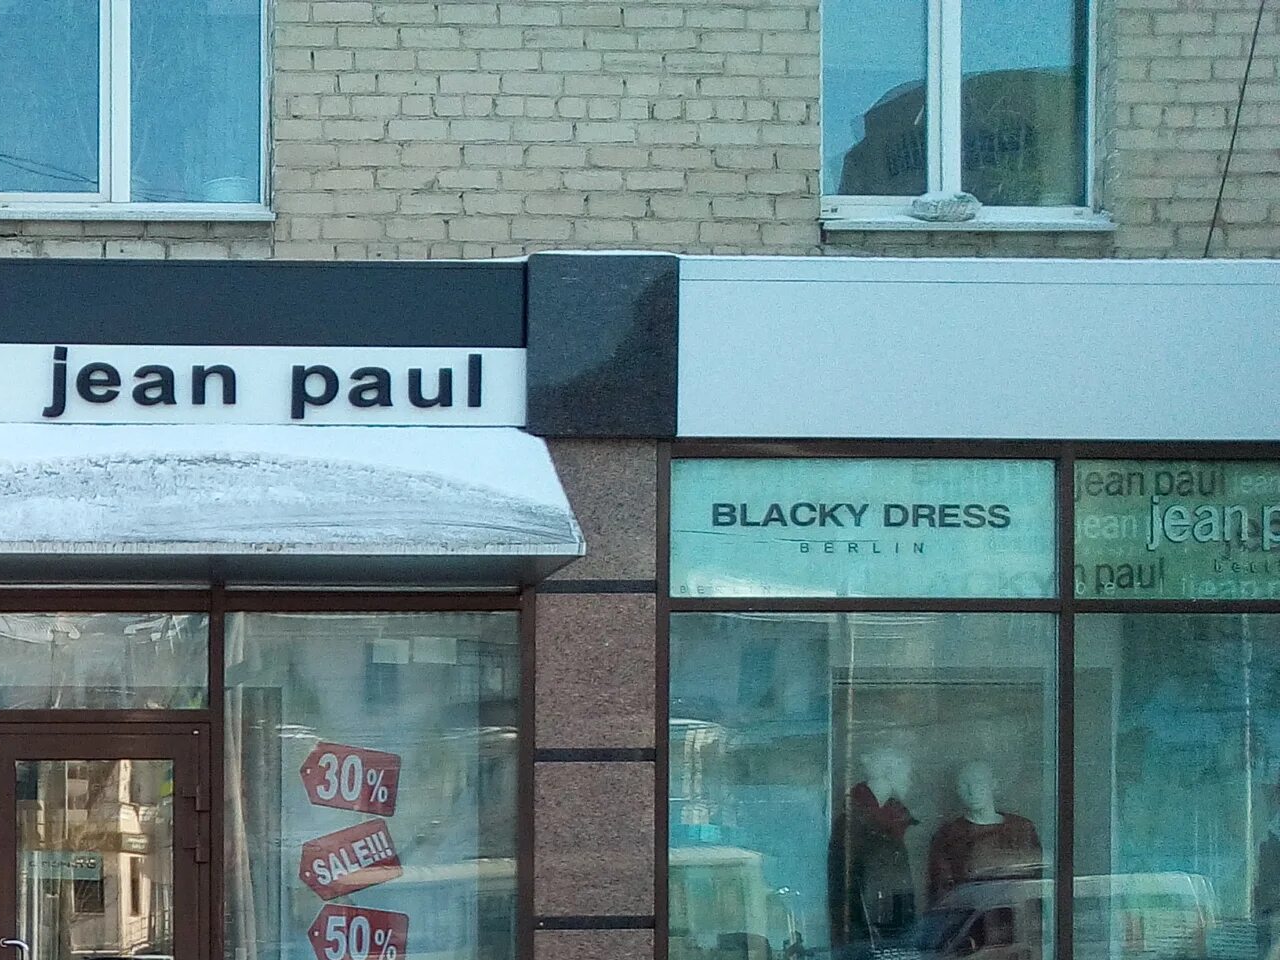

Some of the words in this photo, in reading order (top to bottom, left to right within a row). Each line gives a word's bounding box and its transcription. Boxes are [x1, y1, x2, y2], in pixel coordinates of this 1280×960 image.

[42, 346, 237, 417] jean
[291, 354, 483, 419] paul
[711, 502, 870, 528] BLACKY
[883, 503, 1012, 529] DRESS
[1145, 495, 1250, 552] jean
[800, 541, 926, 555] BERLIN
[316, 753, 388, 803] 30%
[312, 831, 393, 885] SALE!!!
